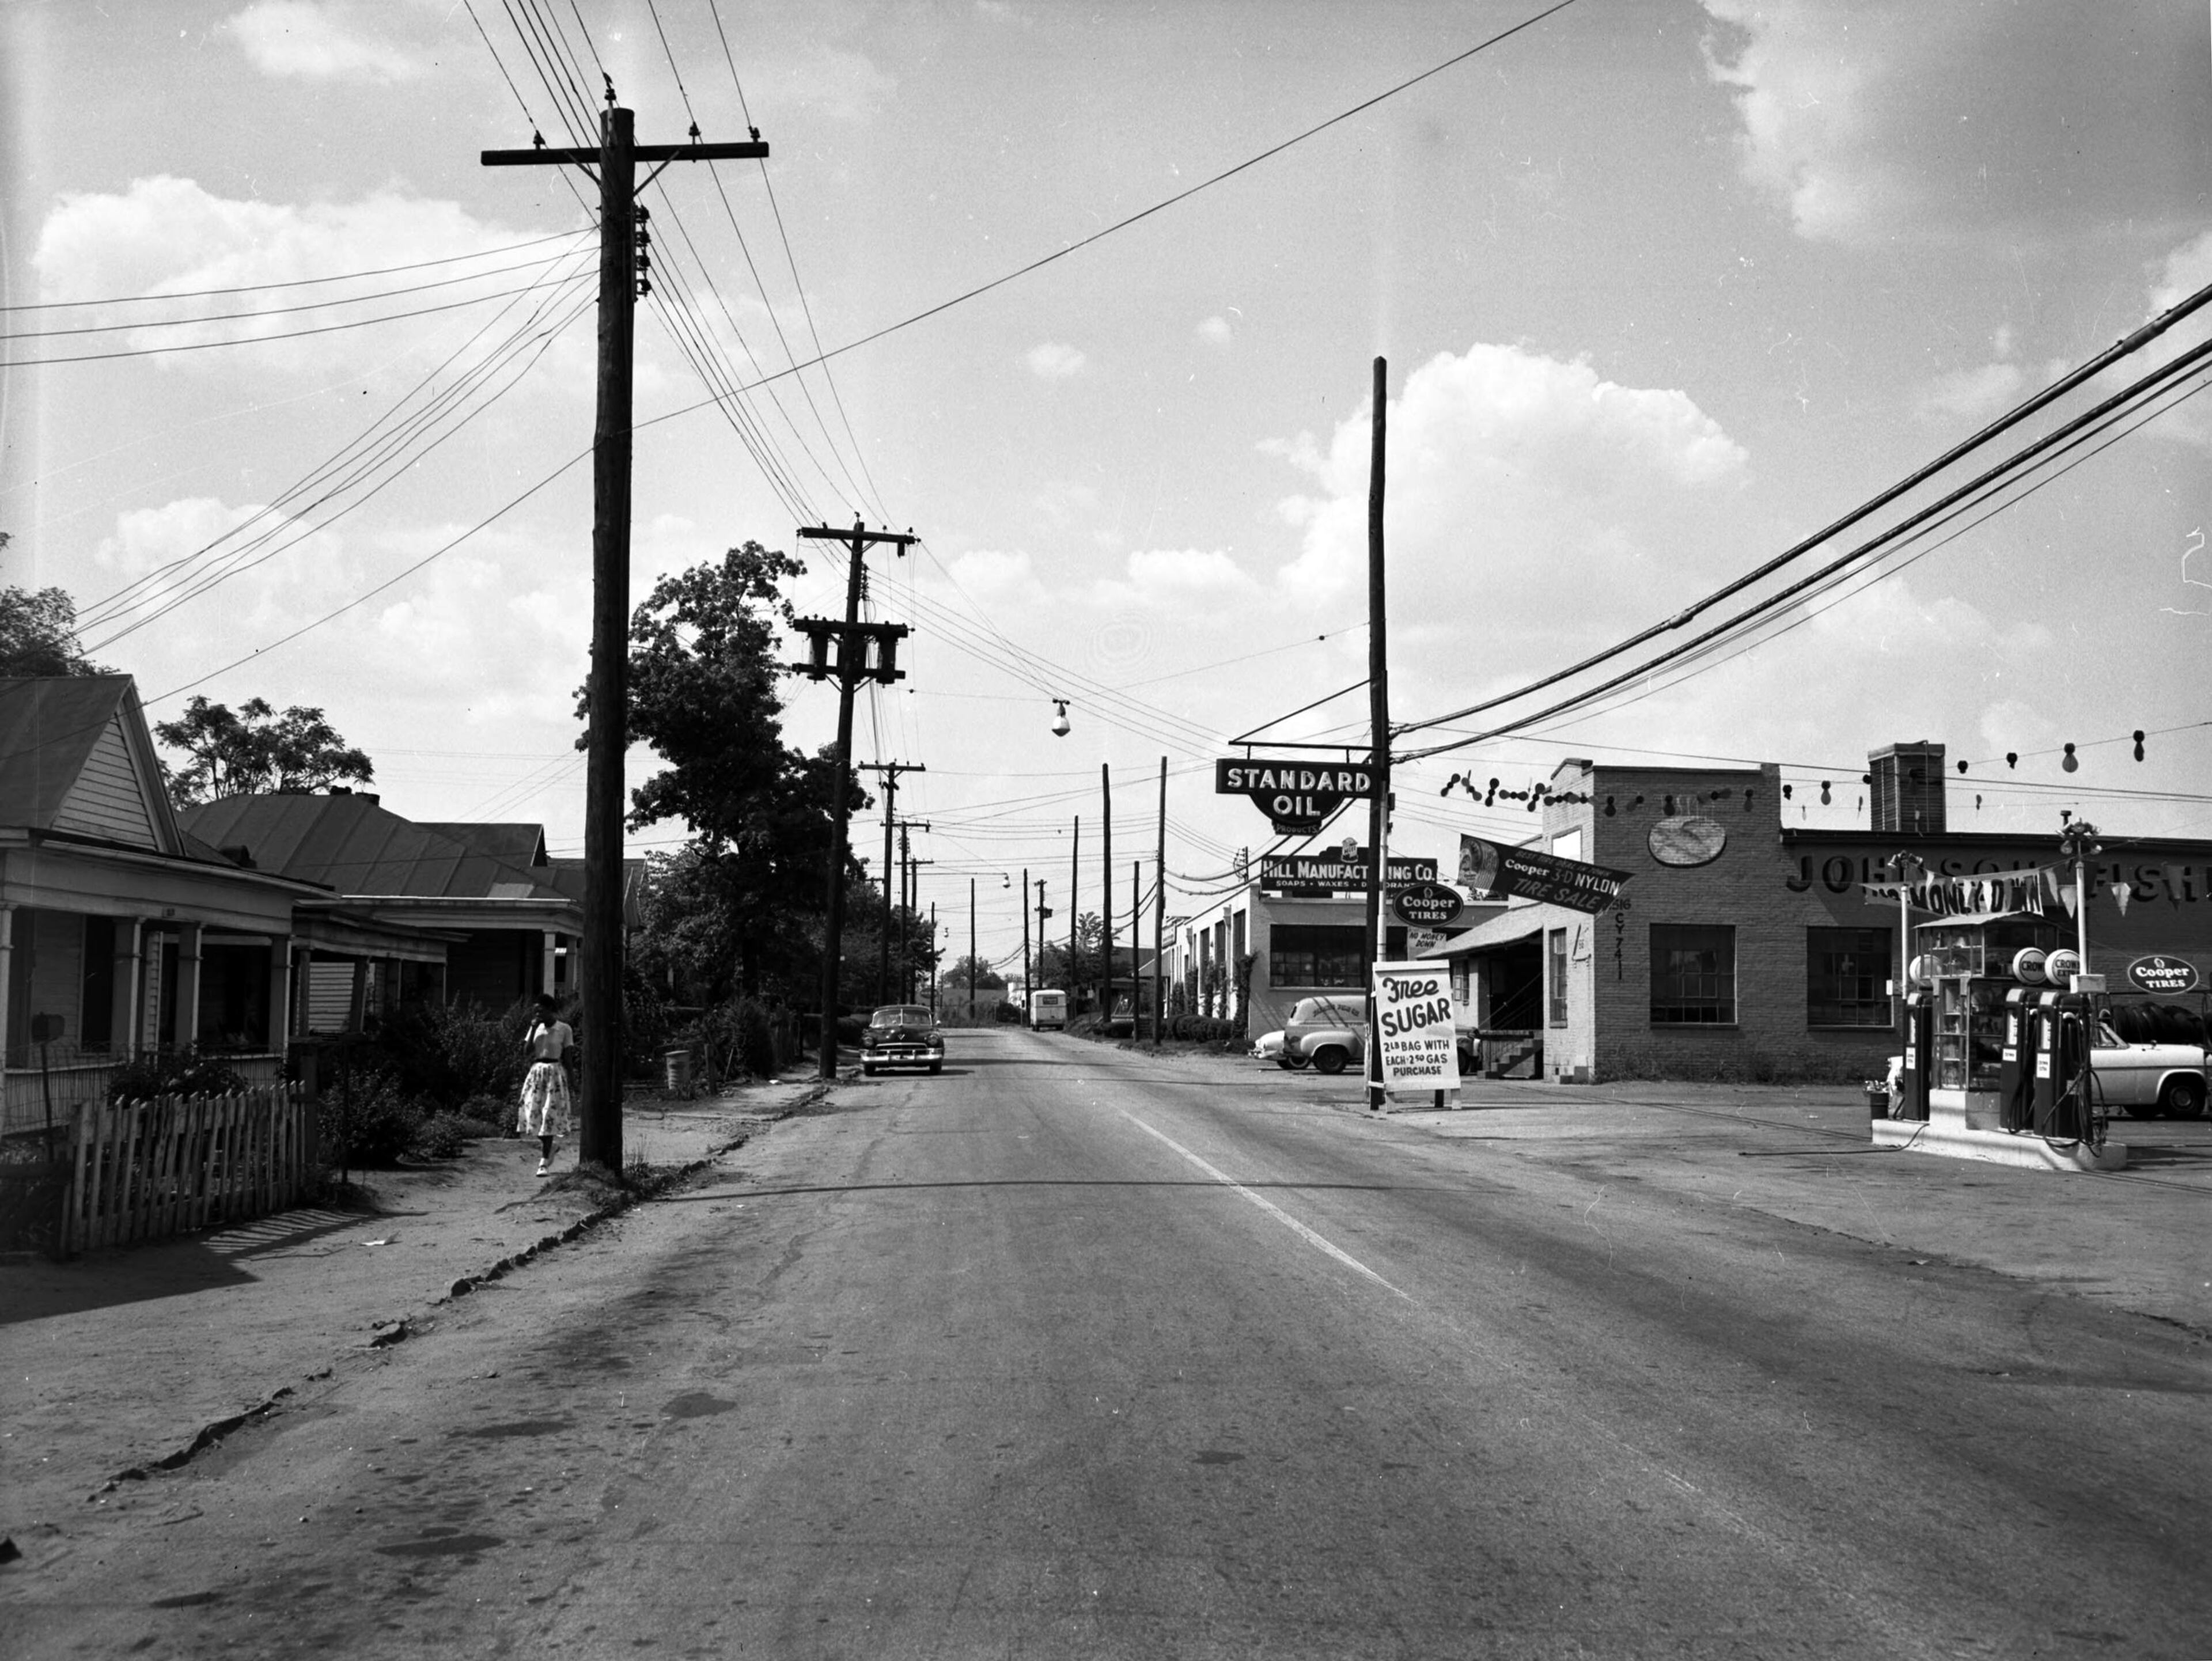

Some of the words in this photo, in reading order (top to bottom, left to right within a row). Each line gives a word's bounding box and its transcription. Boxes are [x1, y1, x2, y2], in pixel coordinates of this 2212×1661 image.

[1228, 768, 1371, 792] STANDARD
[1273, 795, 1321, 817] OIL
[1276, 824, 1319, 833] PRODUCTS
[1263, 860, 1294, 878] HILL
[1297, 860, 1411, 880] MANUFACTING
[1505, 859, 1550, 876] Cooper
[1551, 868, 1573, 883] 3-D
[1574, 873, 1620, 896] NYLON
[1513, 878, 1553, 897] TIRE
[1554, 888, 1601, 909] SALE
[1402, 896, 1456, 910] Cooper
[1408, 911, 1447, 920] TIRES
[1415, 940, 1436, 949] DOWN
[2021, 961, 2045, 972] CROW
[2135, 966, 2190, 979] Cooper
[1382, 977, 1439, 1003] Free
[2145, 979, 2186, 988] TIRES
[1381, 998, 1451, 1037] SUGAR
[1401, 1041, 1422, 1052] BAG
[1424, 1040, 1449, 1051] WITH
[1385, 1056, 1406, 1065] EACH
[1426, 1053, 1448, 1064] GAS
[1393, 1066, 1442, 1076] PURCHASE
